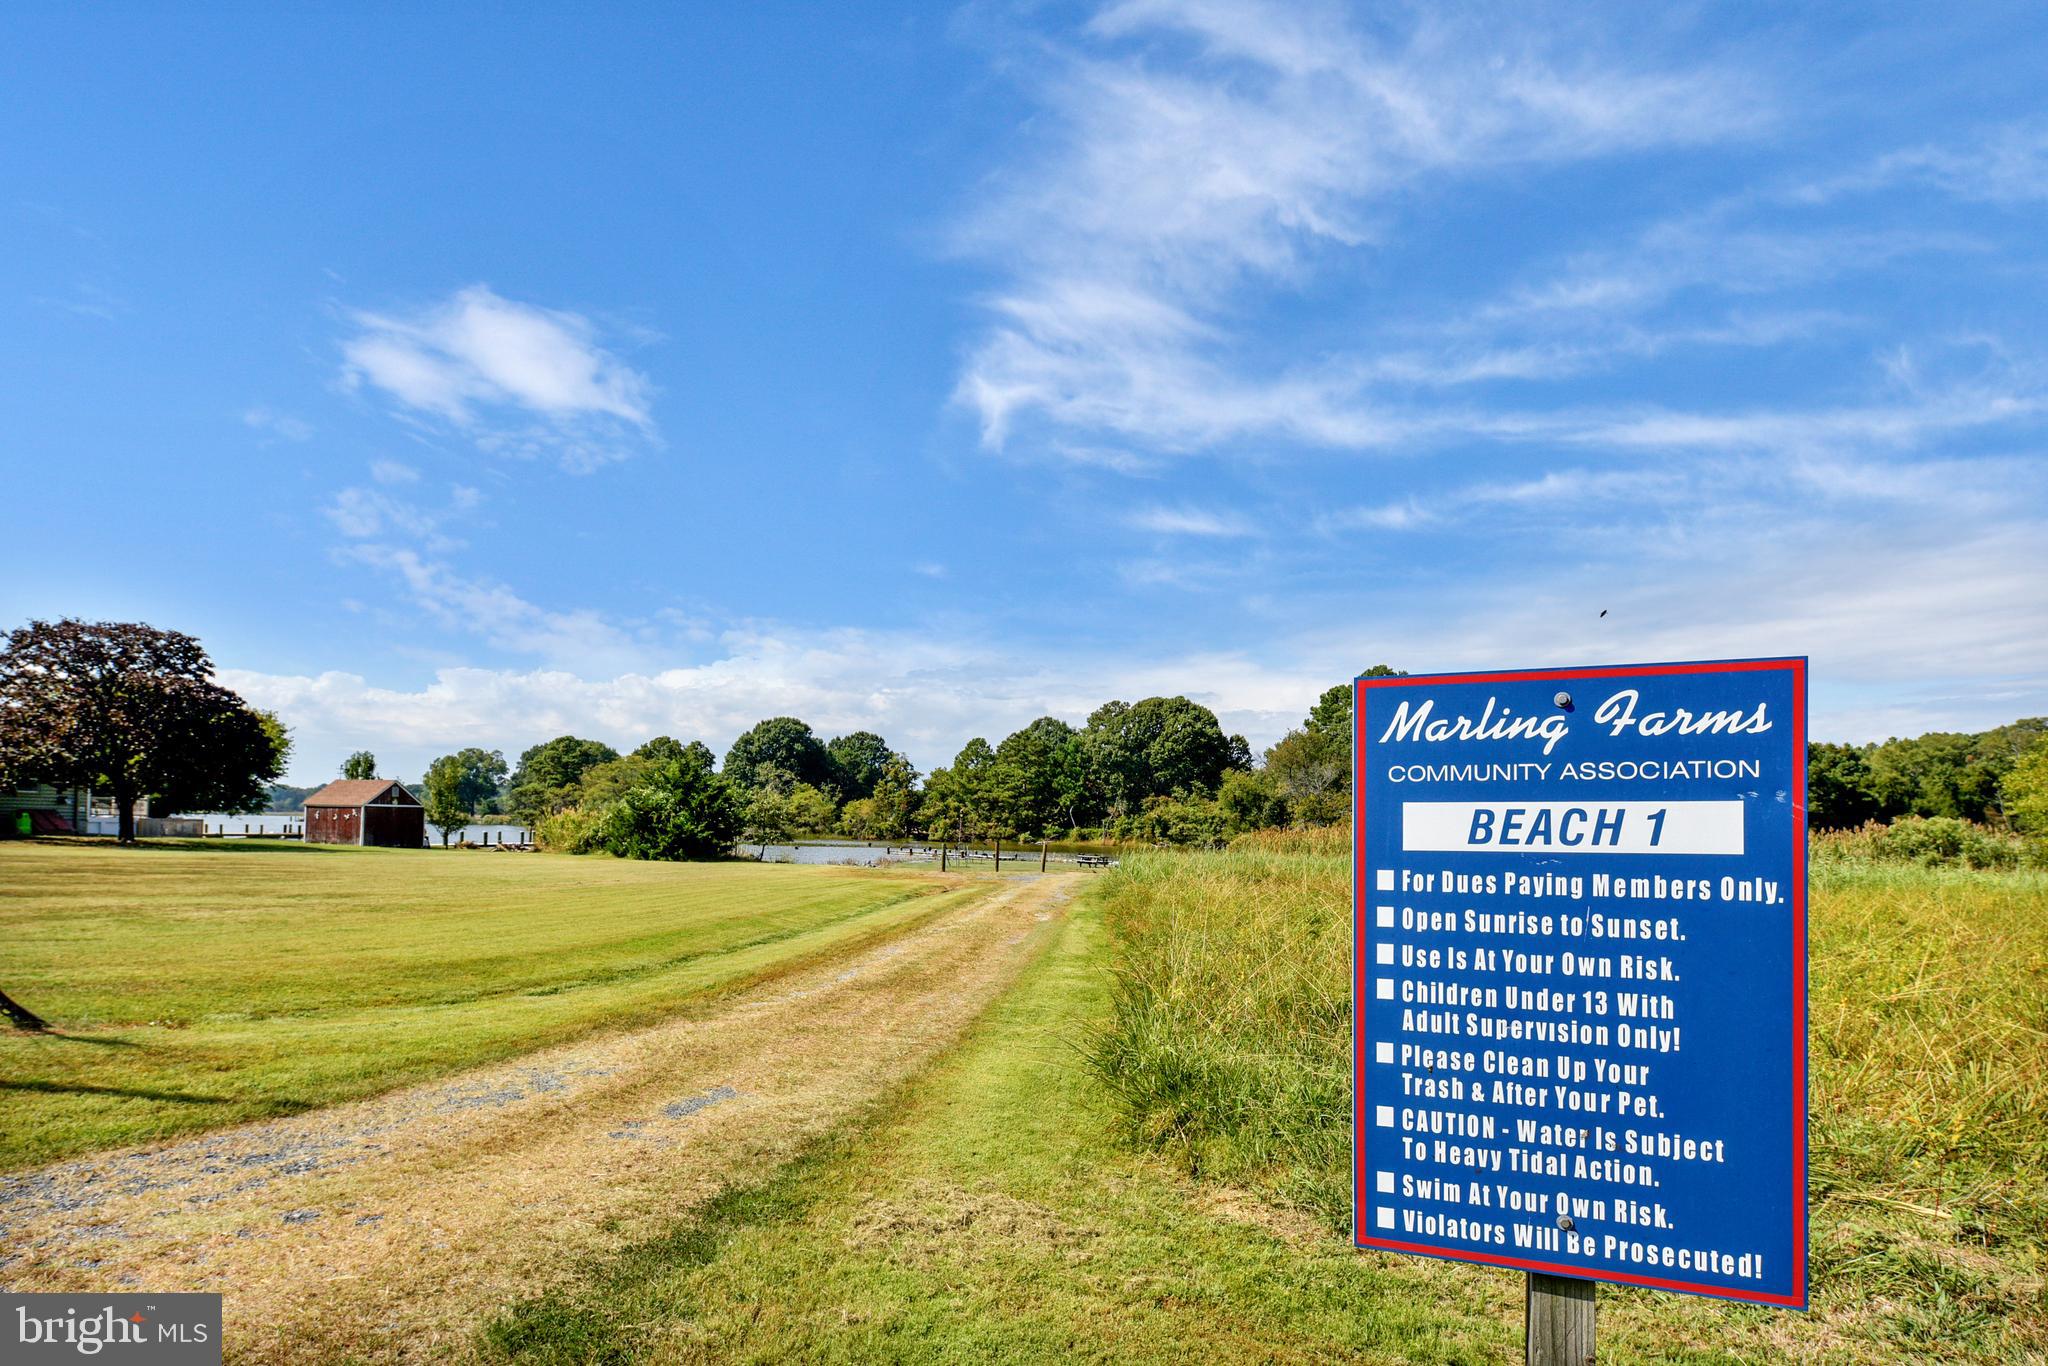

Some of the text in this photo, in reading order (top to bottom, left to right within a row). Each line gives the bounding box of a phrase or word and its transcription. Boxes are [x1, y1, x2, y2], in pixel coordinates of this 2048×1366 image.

[1378, 689, 1773, 755] Marling Farms
[1388, 759, 1760, 783] COMMUNITY ASSOCIATION
[1467, 807, 1667, 847] BEACH 1
[1402, 869, 1784, 905] For Dues Paying Members Only.
[1402, 907, 1686, 942] Open Sunrise to Sunset.
[1402, 944, 1680, 981] Use Is At Your Own Risk.
[1402, 980, 1674, 1020] Children Under 13 With
[1402, 1008, 1681, 1052] Adult Supervision Only!
[1401, 1043, 1649, 1086] Please Clean Up Your
[1402, 1073, 1664, 1119] Trash & After Your Pet.
[1402, 1108, 1495, 1139] CAUTION
[1516, 1118, 1586, 1148] Water
[1595, 1127, 1616, 1151] Is
[1624, 1129, 1725, 1163] Subject
[1402, 1137, 1660, 1188] To Heavy Tidal Action.
[1402, 1174, 1674, 1230] Swim At Your Own Risk.
[1402, 1209, 1763, 1279] Violators Will Be Prosecuted!
